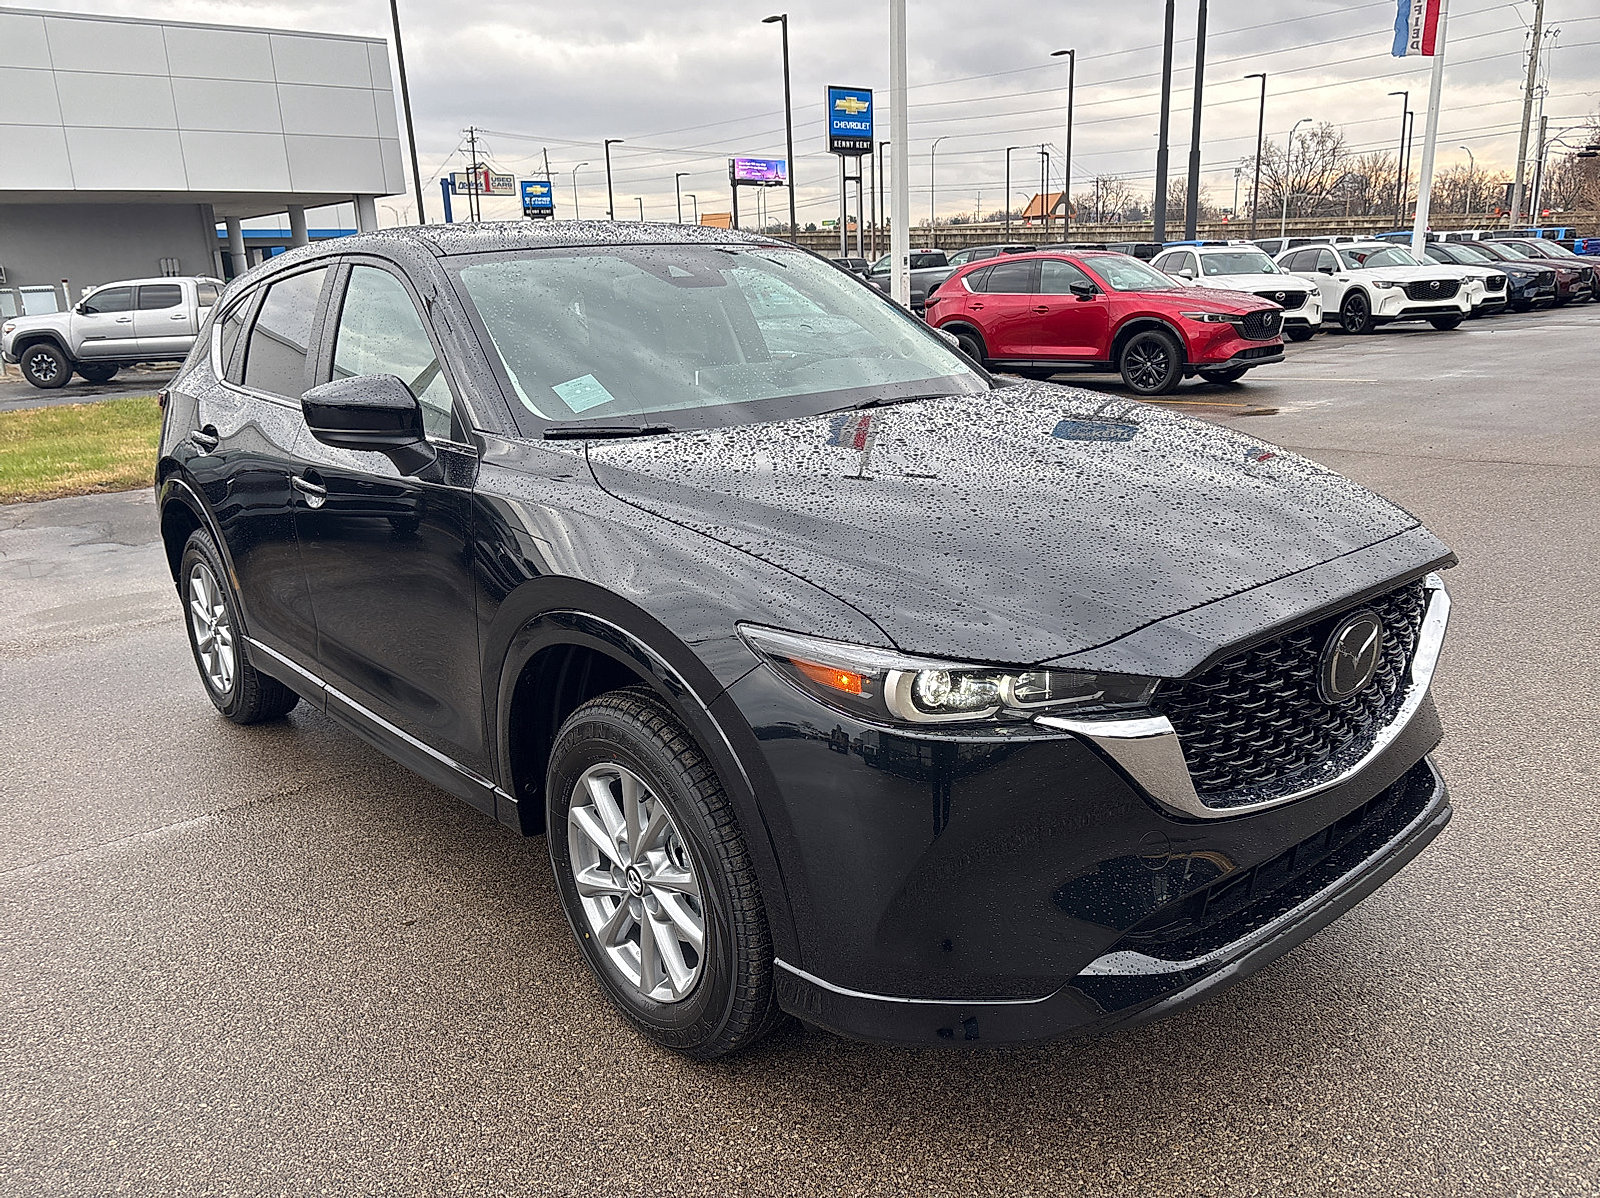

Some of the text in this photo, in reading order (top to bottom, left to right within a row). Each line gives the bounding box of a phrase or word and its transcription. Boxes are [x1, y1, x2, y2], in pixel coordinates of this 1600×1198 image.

[833, 120, 870, 130] CHEVROLET
[833, 140, 871, 149] KENNY KENT
